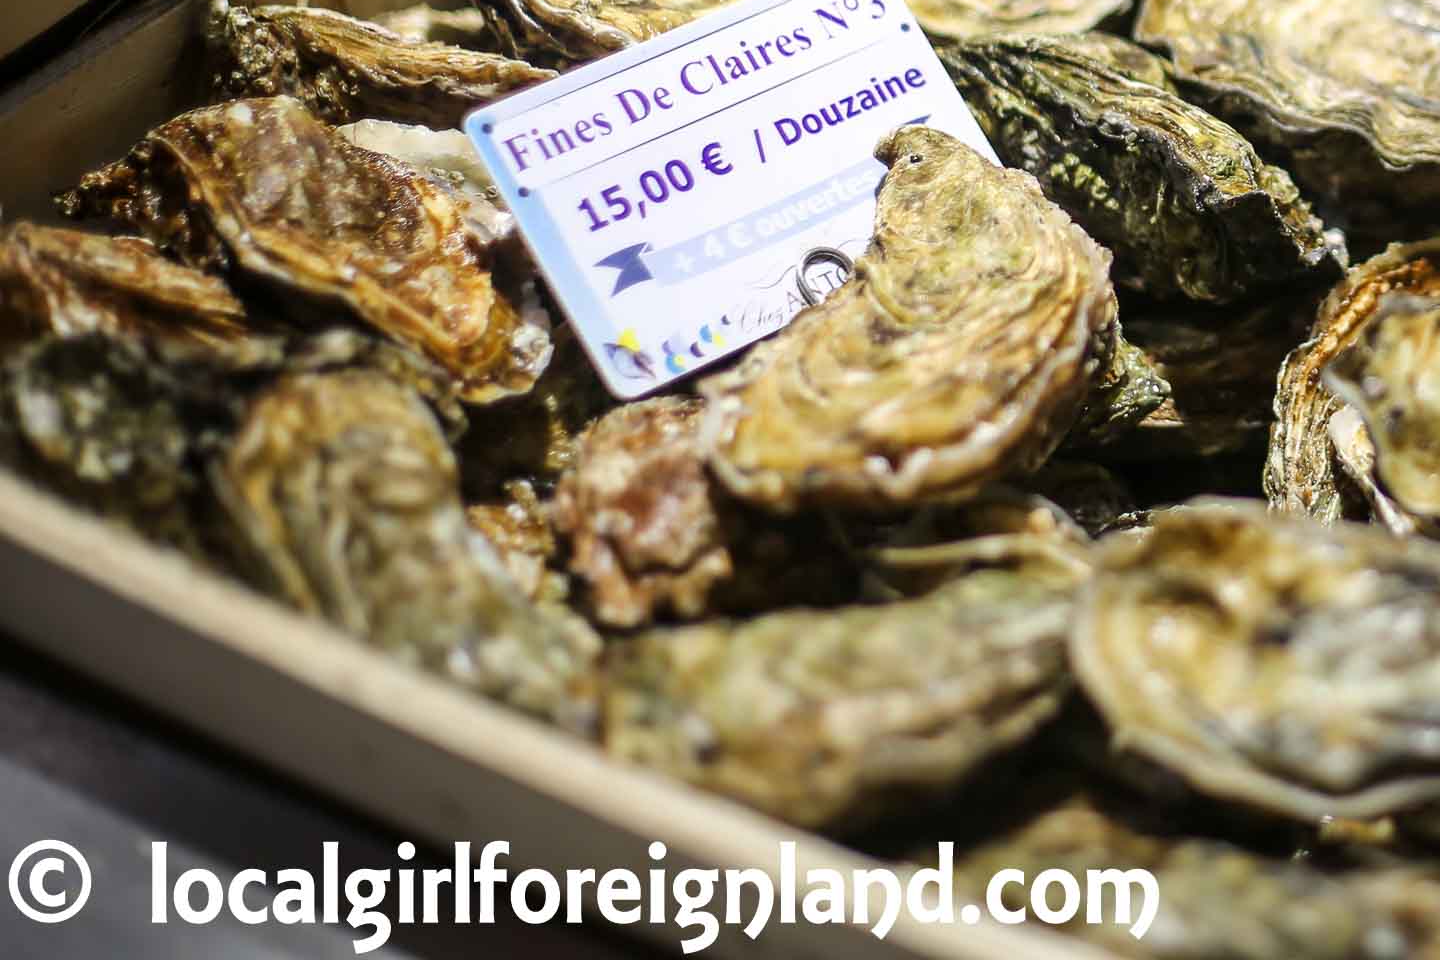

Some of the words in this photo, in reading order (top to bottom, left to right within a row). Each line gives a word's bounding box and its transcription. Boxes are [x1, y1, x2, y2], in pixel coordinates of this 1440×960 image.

[503, 112, 612, 172] Fines
[615, 87, 674, 125] De
[679, 26, 812, 96] Claires
[577, 159, 695, 233] 15,00
[700, 141, 734, 176] €
[753, 128, 767, 164] /
[773, 67, 927, 147] Douzaine
